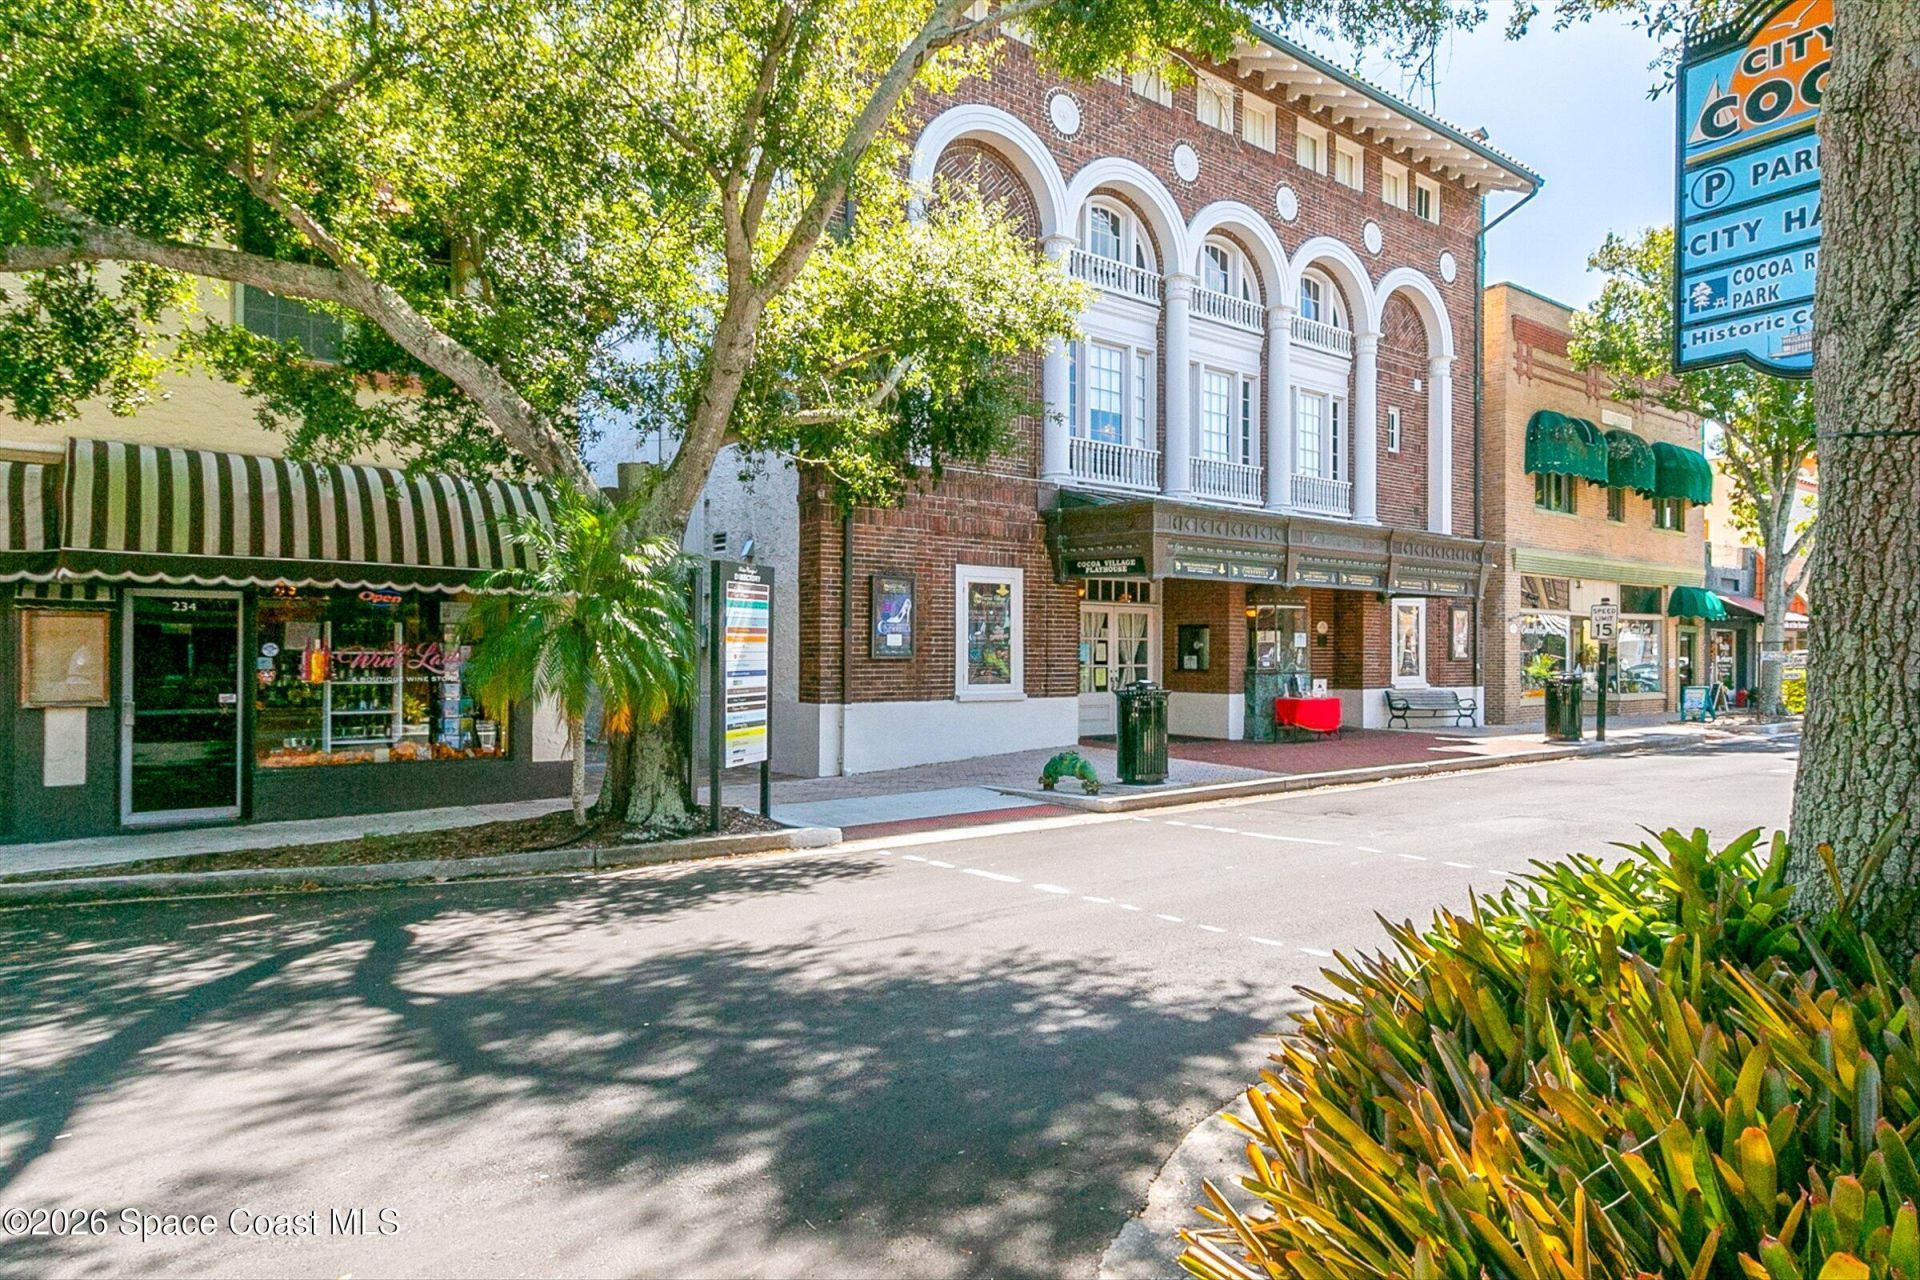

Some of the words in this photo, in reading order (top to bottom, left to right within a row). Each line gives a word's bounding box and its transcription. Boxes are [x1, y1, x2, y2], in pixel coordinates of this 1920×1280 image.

[1742, 23, 1834, 76] CITY
[1704, 172, 1726, 204] P
[1752, 144, 1821, 186] PAR
[1690, 218, 1763, 257] CITY
[1732, 257, 1794, 286] COCOA
[1732, 283, 1780, 309] PARK
[1691, 315, 1785, 346] Historic
[1076, 560, 1102, 569] COCOA
[1103, 558, 1137, 568] VILLAGE
[1084, 565, 1128, 574] PLAYHOUSE
[358, 590, 402, 604] Open
[171, 601, 197, 612] 234
[1592, 607, 1616, 615] SPEED
[1595, 623, 1612, 637] 15
[406, 675, 429, 683] WINE
